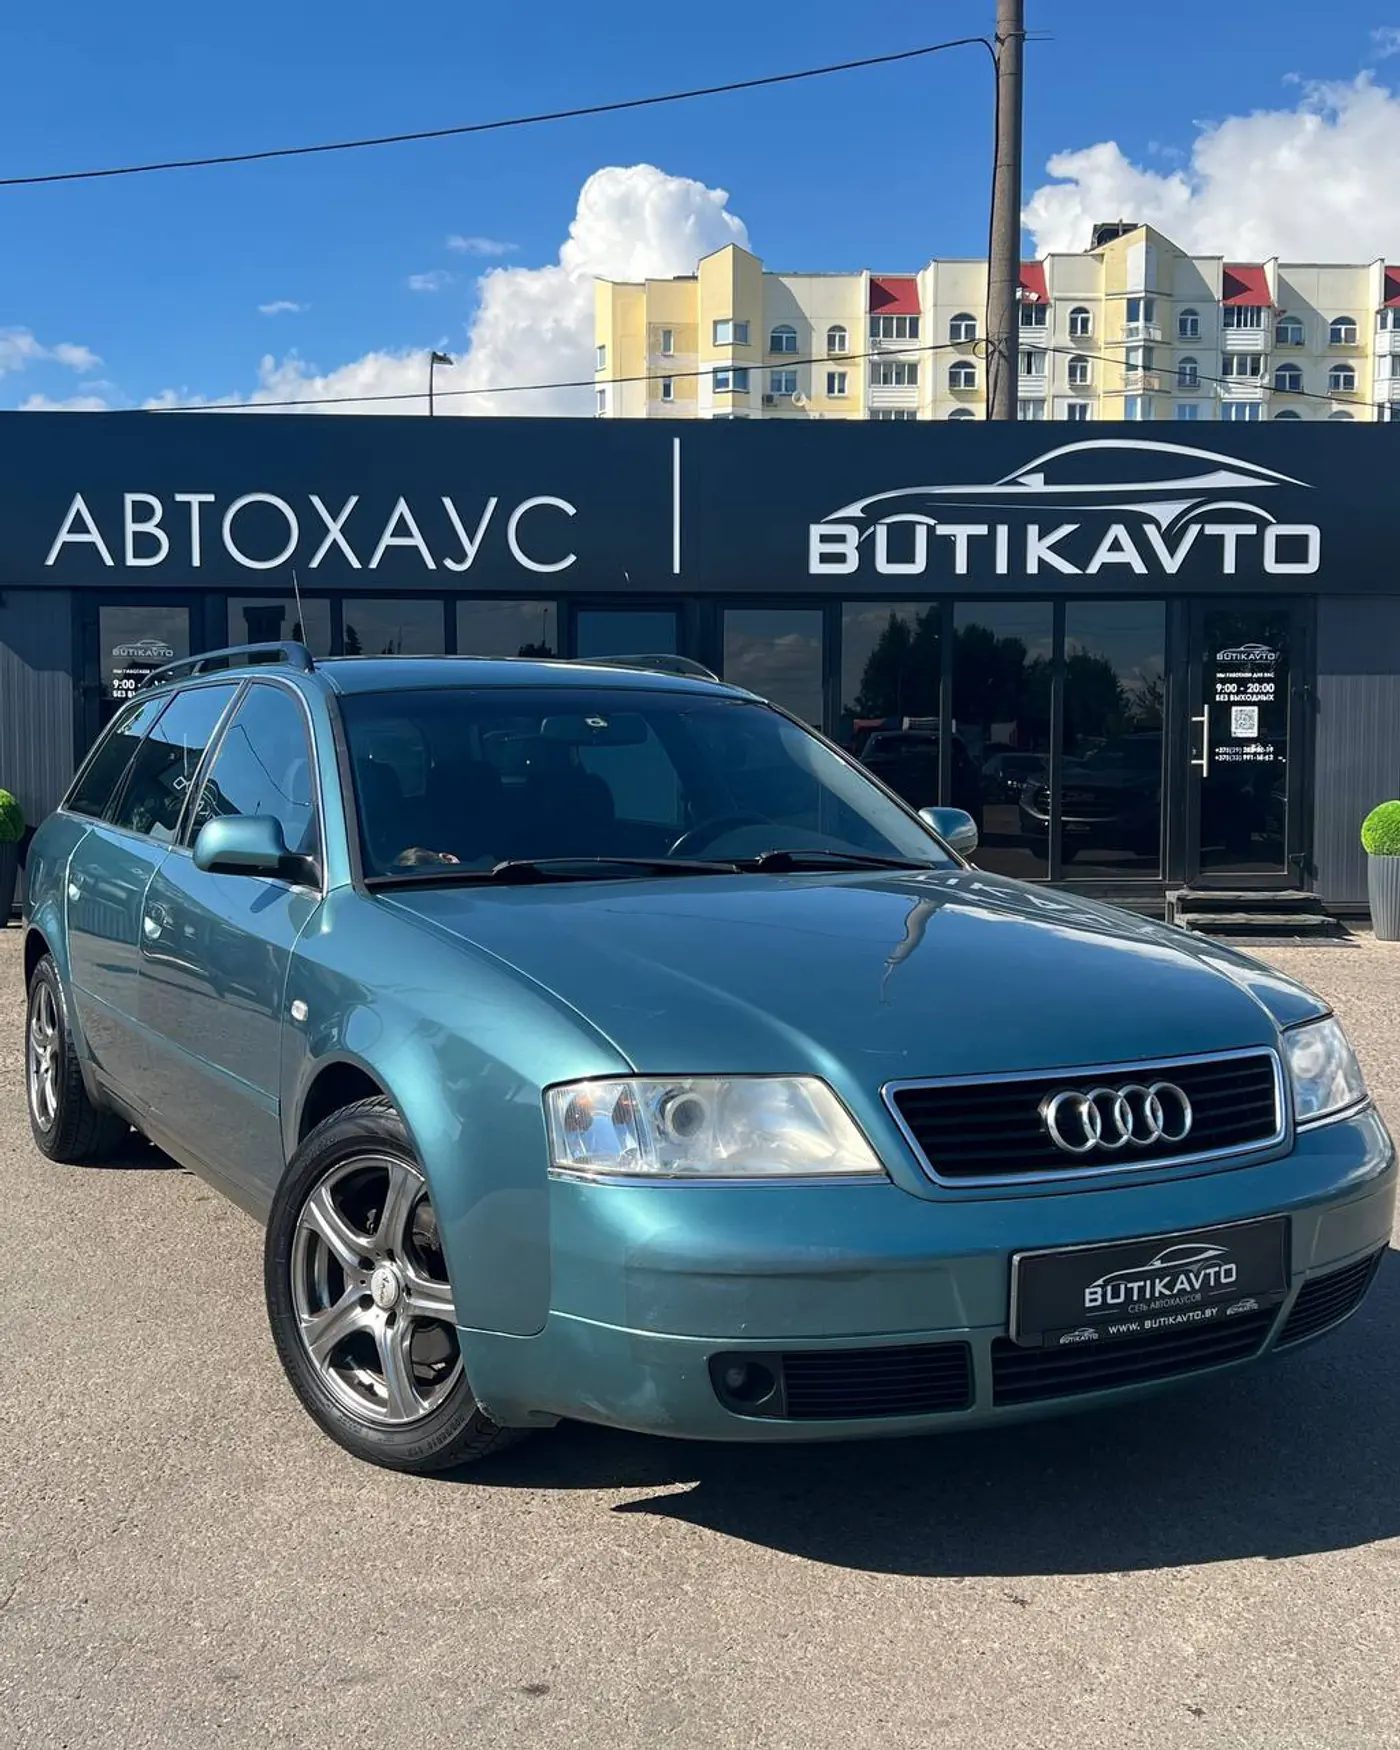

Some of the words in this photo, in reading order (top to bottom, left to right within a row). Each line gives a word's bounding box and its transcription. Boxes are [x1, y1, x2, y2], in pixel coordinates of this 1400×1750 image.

[44, 492, 578, 573] АВТОХАУС
[807, 522, 1322, 576] BUTIKAVTO
[112, 648, 174, 657] BUTIKAVTO
[113, 679, 136, 689] 9:00
[1215, 683, 1238, 693] 9:00
[1246, 683, 1275, 693] 20:00
[1215, 694, 1229, 702] БЕЗ
[1230, 694, 1275, 702] ВЫХОДНЫХ
[1084, 1263, 1237, 1308] BUTIKAVTO
[1127, 1302, 1149, 1314] СЕТЬ
[1149, 1293, 1202, 1310] АВТОХАУСОВ
[1108, 1321, 1140, 1334] WWW.
[1144, 1307, 1218, 1329] BUTIKAVTO.BY
